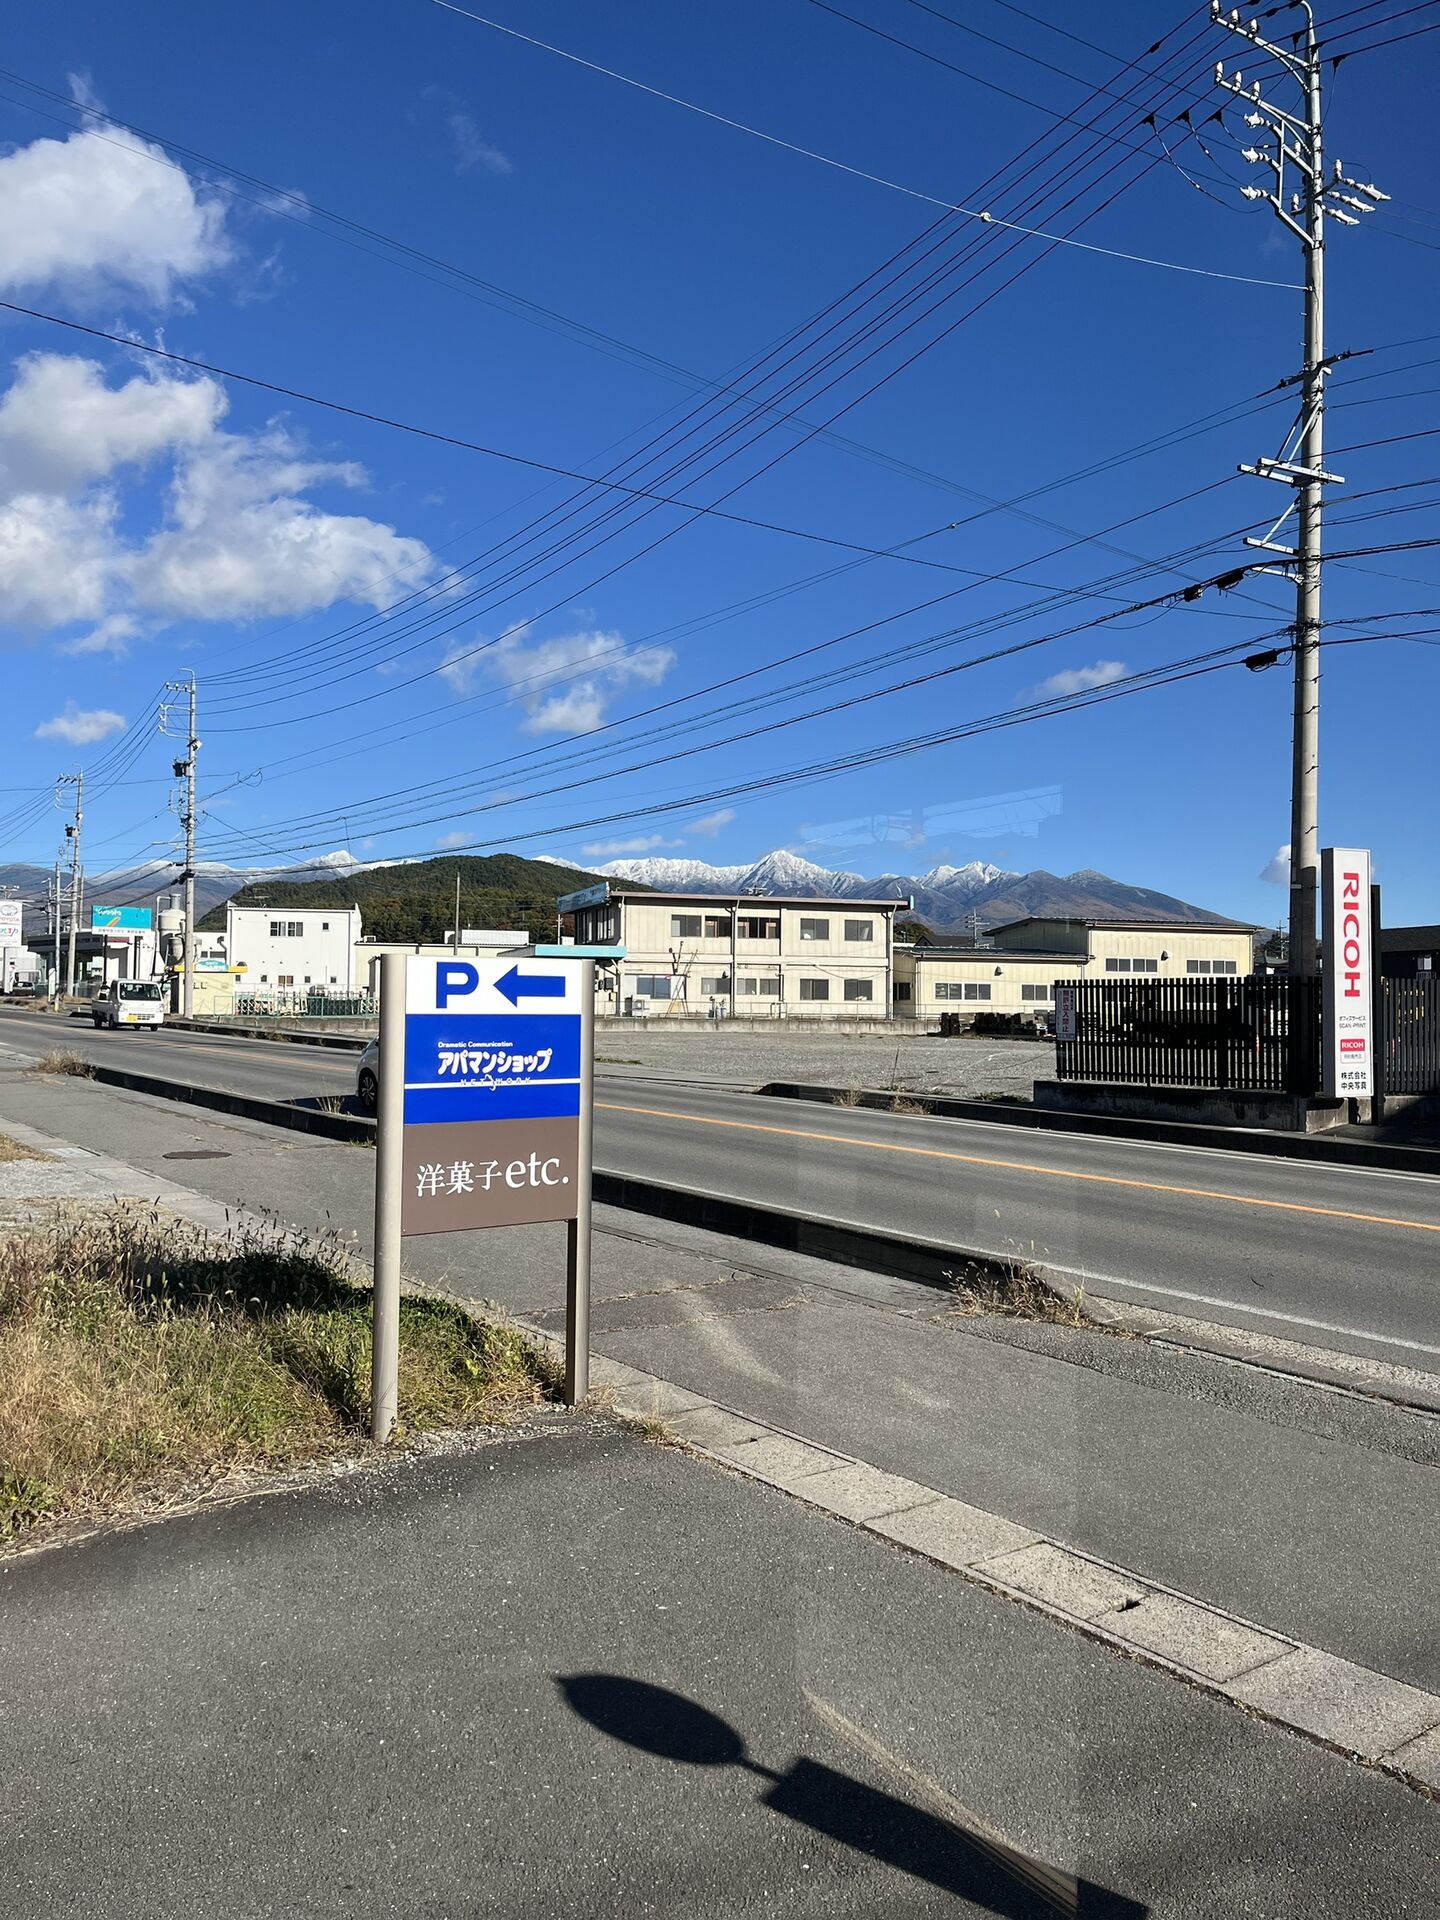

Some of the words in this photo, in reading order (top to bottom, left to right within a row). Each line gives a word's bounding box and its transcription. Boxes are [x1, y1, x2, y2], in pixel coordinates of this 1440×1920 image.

[1343, 872, 1360, 997] RICOH
[435, 961, 480, 1009] P
[467, 1040, 514, 1048] Communication
[437, 1048, 553, 1075] アパマンショップ
[1341, 1071, 1367, 1080] 株式会社
[1341, 1081, 1367, 1090] 中央写真
